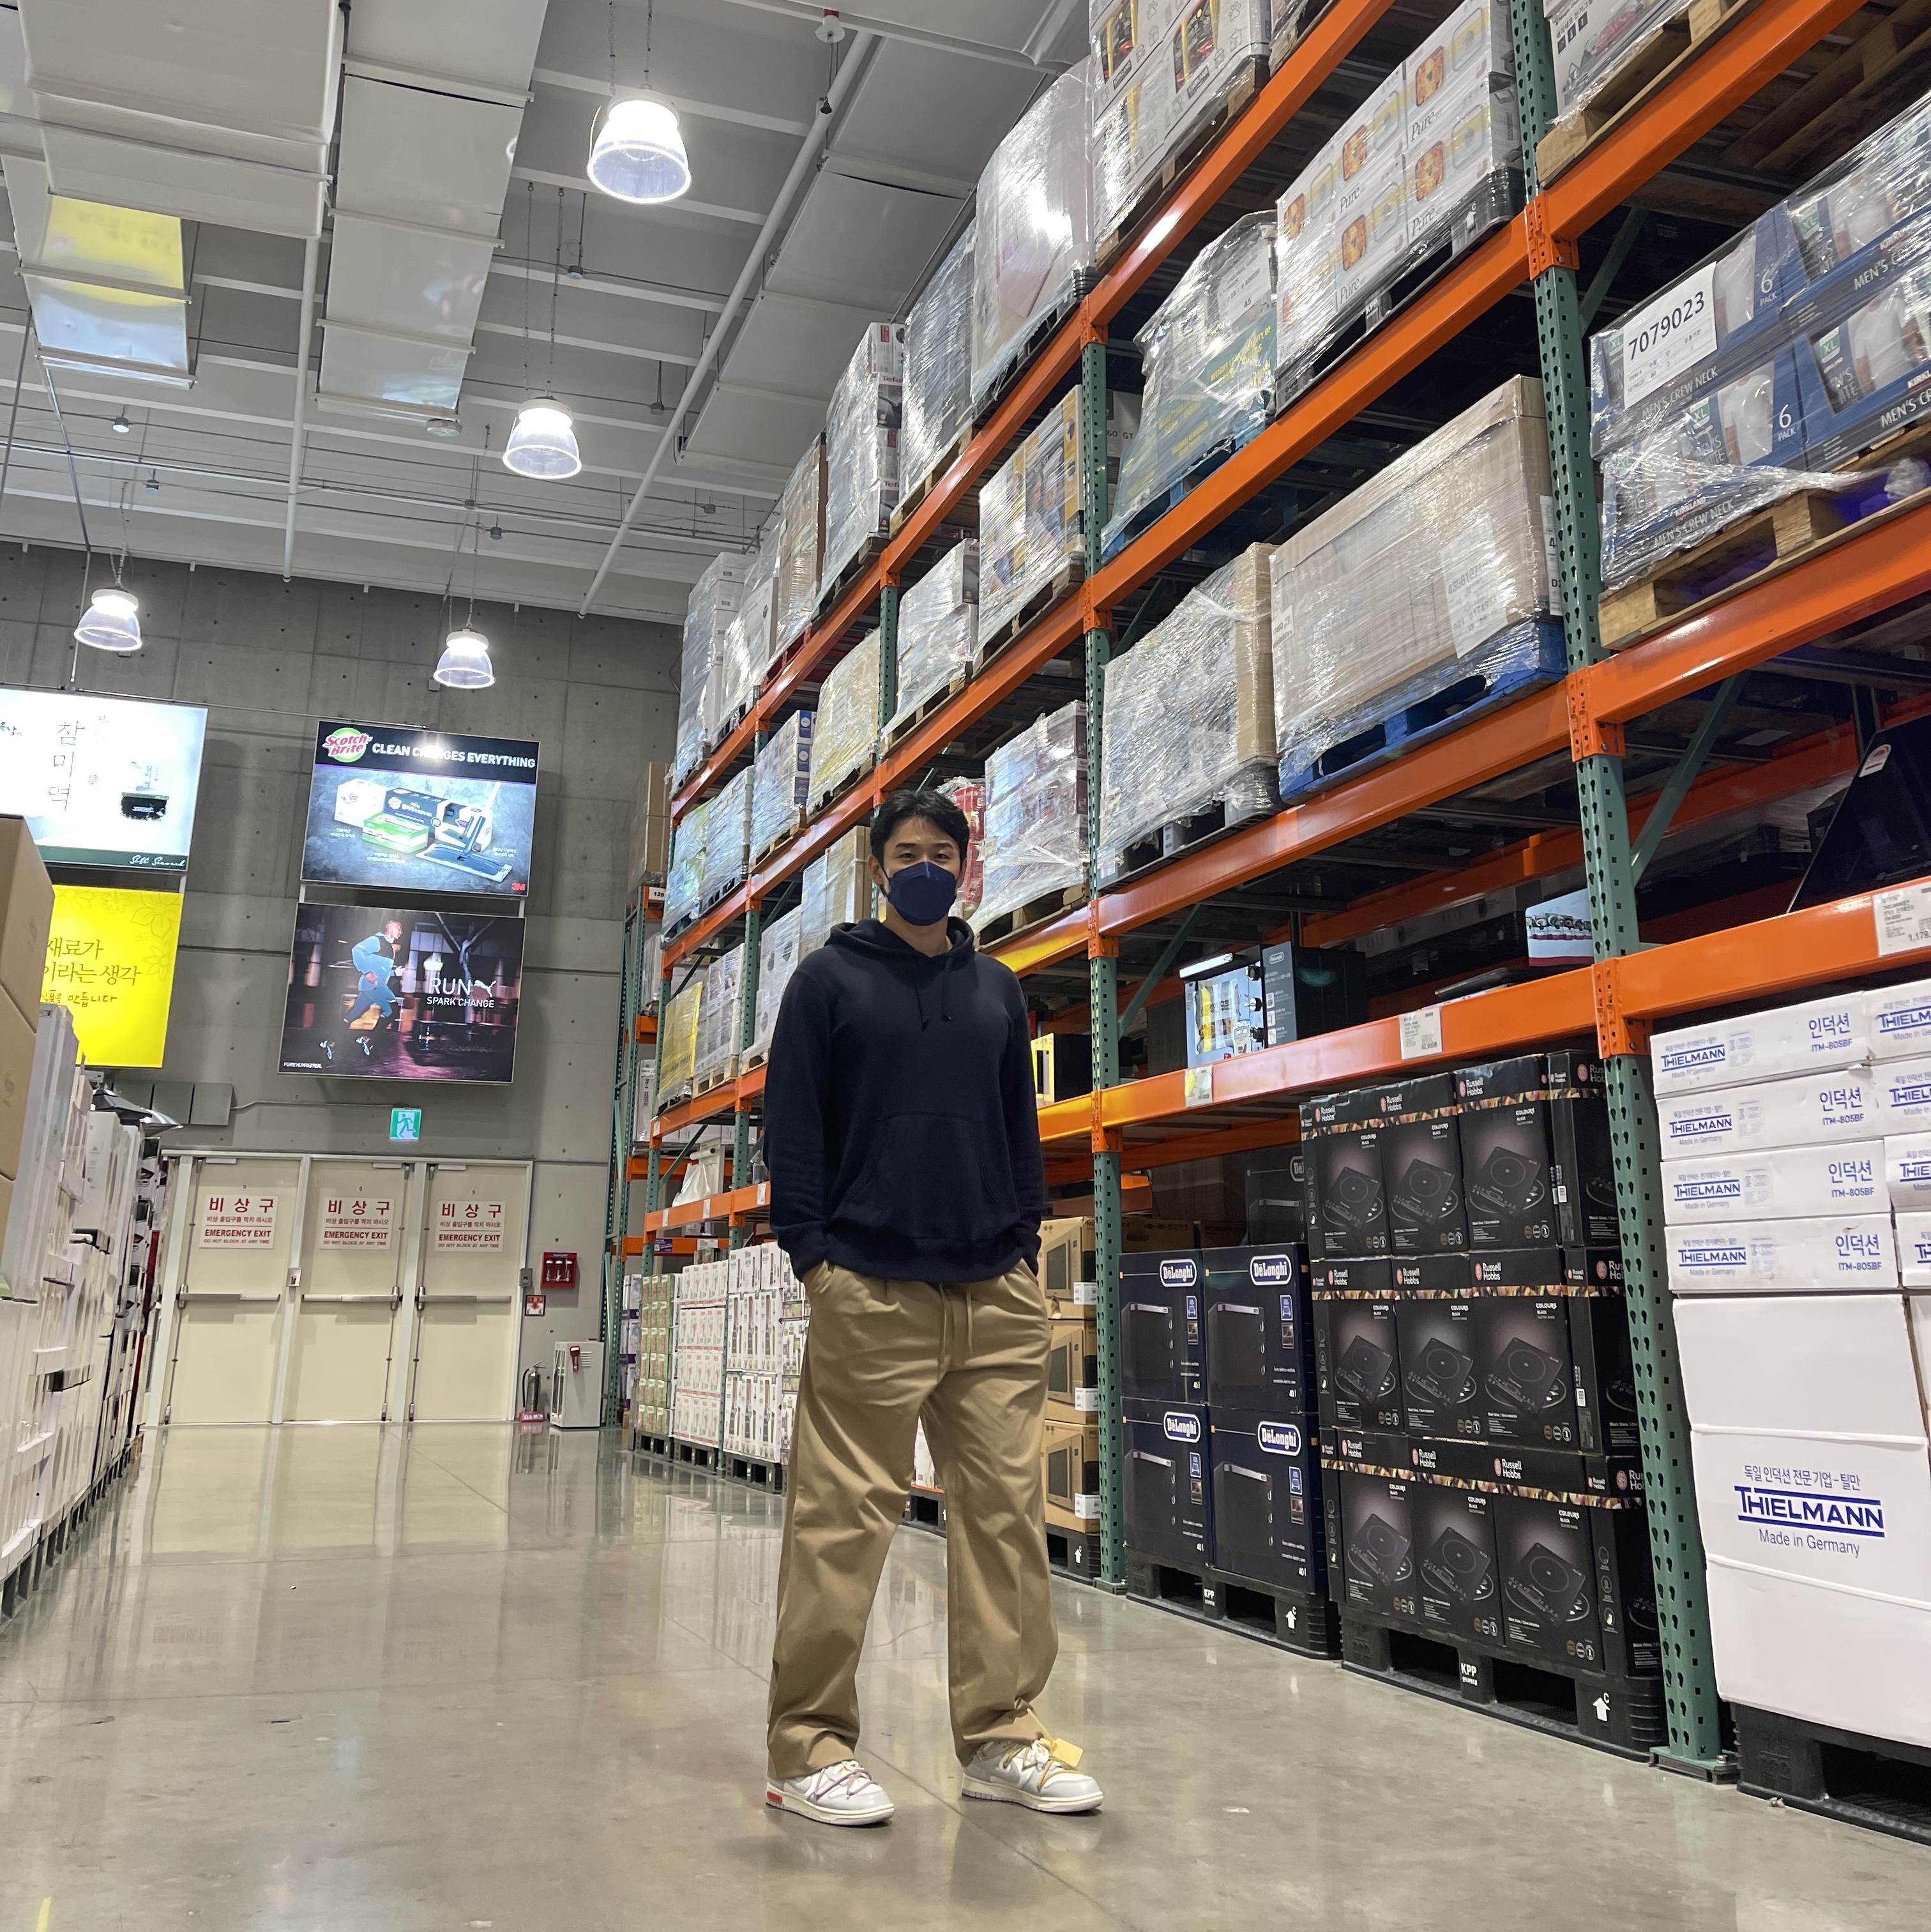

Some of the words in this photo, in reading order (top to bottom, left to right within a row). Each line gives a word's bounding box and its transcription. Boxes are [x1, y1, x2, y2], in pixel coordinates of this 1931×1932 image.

[1411, 110, 1434, 142] Pure
[1340, 186, 1359, 213] Pure
[1412, 208, 1435, 238] Pure
[1761, 270, 1773, 294] 6
[1760, 291, 1778, 307] PACK
[1628, 291, 1704, 360] 7079023
[1822, 338, 1840, 355] XL
[1695, 365, 1718, 388] NECK
[1692, 407, 1709, 423] XL
[1779, 404, 1792, 429] 6
[1881, 396, 1916, 427] MEN'S
[1123, 432, 1133, 440] GT
[1778, 427, 1796, 442] PACK
[330, 744, 364, 756] Brite
[372, 743, 410, 756] CLEAN
[467, 752, 536, 768] EVERYTHING
[511, 883, 526, 892] 3M
[100, 964, 142, 987] 생각
[428, 977, 472, 996] RUN
[68, 991, 118, 1008] 만듭니다
[427, 996, 456, 1007] SPARK
[458, 998, 495, 1008] CHANGE
[1808, 1012, 1851, 1039] 인덕션
[1893, 1032, 1912, 1040] Made
[1812, 1038, 1852, 1053] ITM-805BF
[1661, 1047, 1725, 1068] THIELMANN
[1466, 1077, 1484, 1088] Russell
[1467, 1086, 1483, 1097] Hobbs
[1386, 1093, 1403, 1104] Russell
[1820, 1086, 1862, 1112] 인덕션
[1904, 1107, 1922, 1115] Made
[1822, 1113, 1864, 1125] ITM-805BF
[1669, 1118, 1732, 1134] THIELMANN
[1829, 1160, 1873, 1183] 인덕션
[1674, 1183, 1741, 1198] THIELMANN
[1831, 1187, 1874, 1198] ITM-805BF
[204, 1229, 252, 1237] EMERGENCY
[324, 1231, 370, 1239] EMERGENCY
[1835, 1233, 1880, 1257] 인덕션
[1678, 1251, 1746, 1263] THIELMANN
[1482, 1262, 1501, 1272] Russell
[1838, 1262, 1882, 1270] ITM-805BF
[1334, 1269, 1349, 1278] Russell
[1403, 1268, 1420, 1277] Russell
[1483, 1272, 1501, 1281] Hobbs
[1334, 1277, 1348, 1286] Hobbs
[1404, 1277, 1420, 1285] Hobbs
[1347, 1440, 1362, 1450] Russell
[1348, 1450, 1362, 1458] Hobbs
[1419, 1449, 1436, 1460] Russell
[1420, 1459, 1435, 1468] Hobbs
[1501, 1458, 1522, 1470] Russell
[1503, 1469, 1521, 1480] Hobbs
[1745, 1464, 1762, 1482] 독일
[1763, 1466, 1791, 1485] 인덕션
[1793, 1469, 1812, 1487] 전문
[1734, 1485, 1884, 1529] THIELMANN
[1559, 1509, 1580, 1520] COLOURS
[1759, 1528, 1790, 1546] Made
[1793, 1533, 1803, 1548] in
[1806, 1534, 1859, 1558] Germany
[1204, 1588, 1215, 1599] KPP
[1292, 1606, 1297, 1615] C
[1460, 1662, 1477, 1677] KPP
[1603, 1692, 1610, 1704] C
